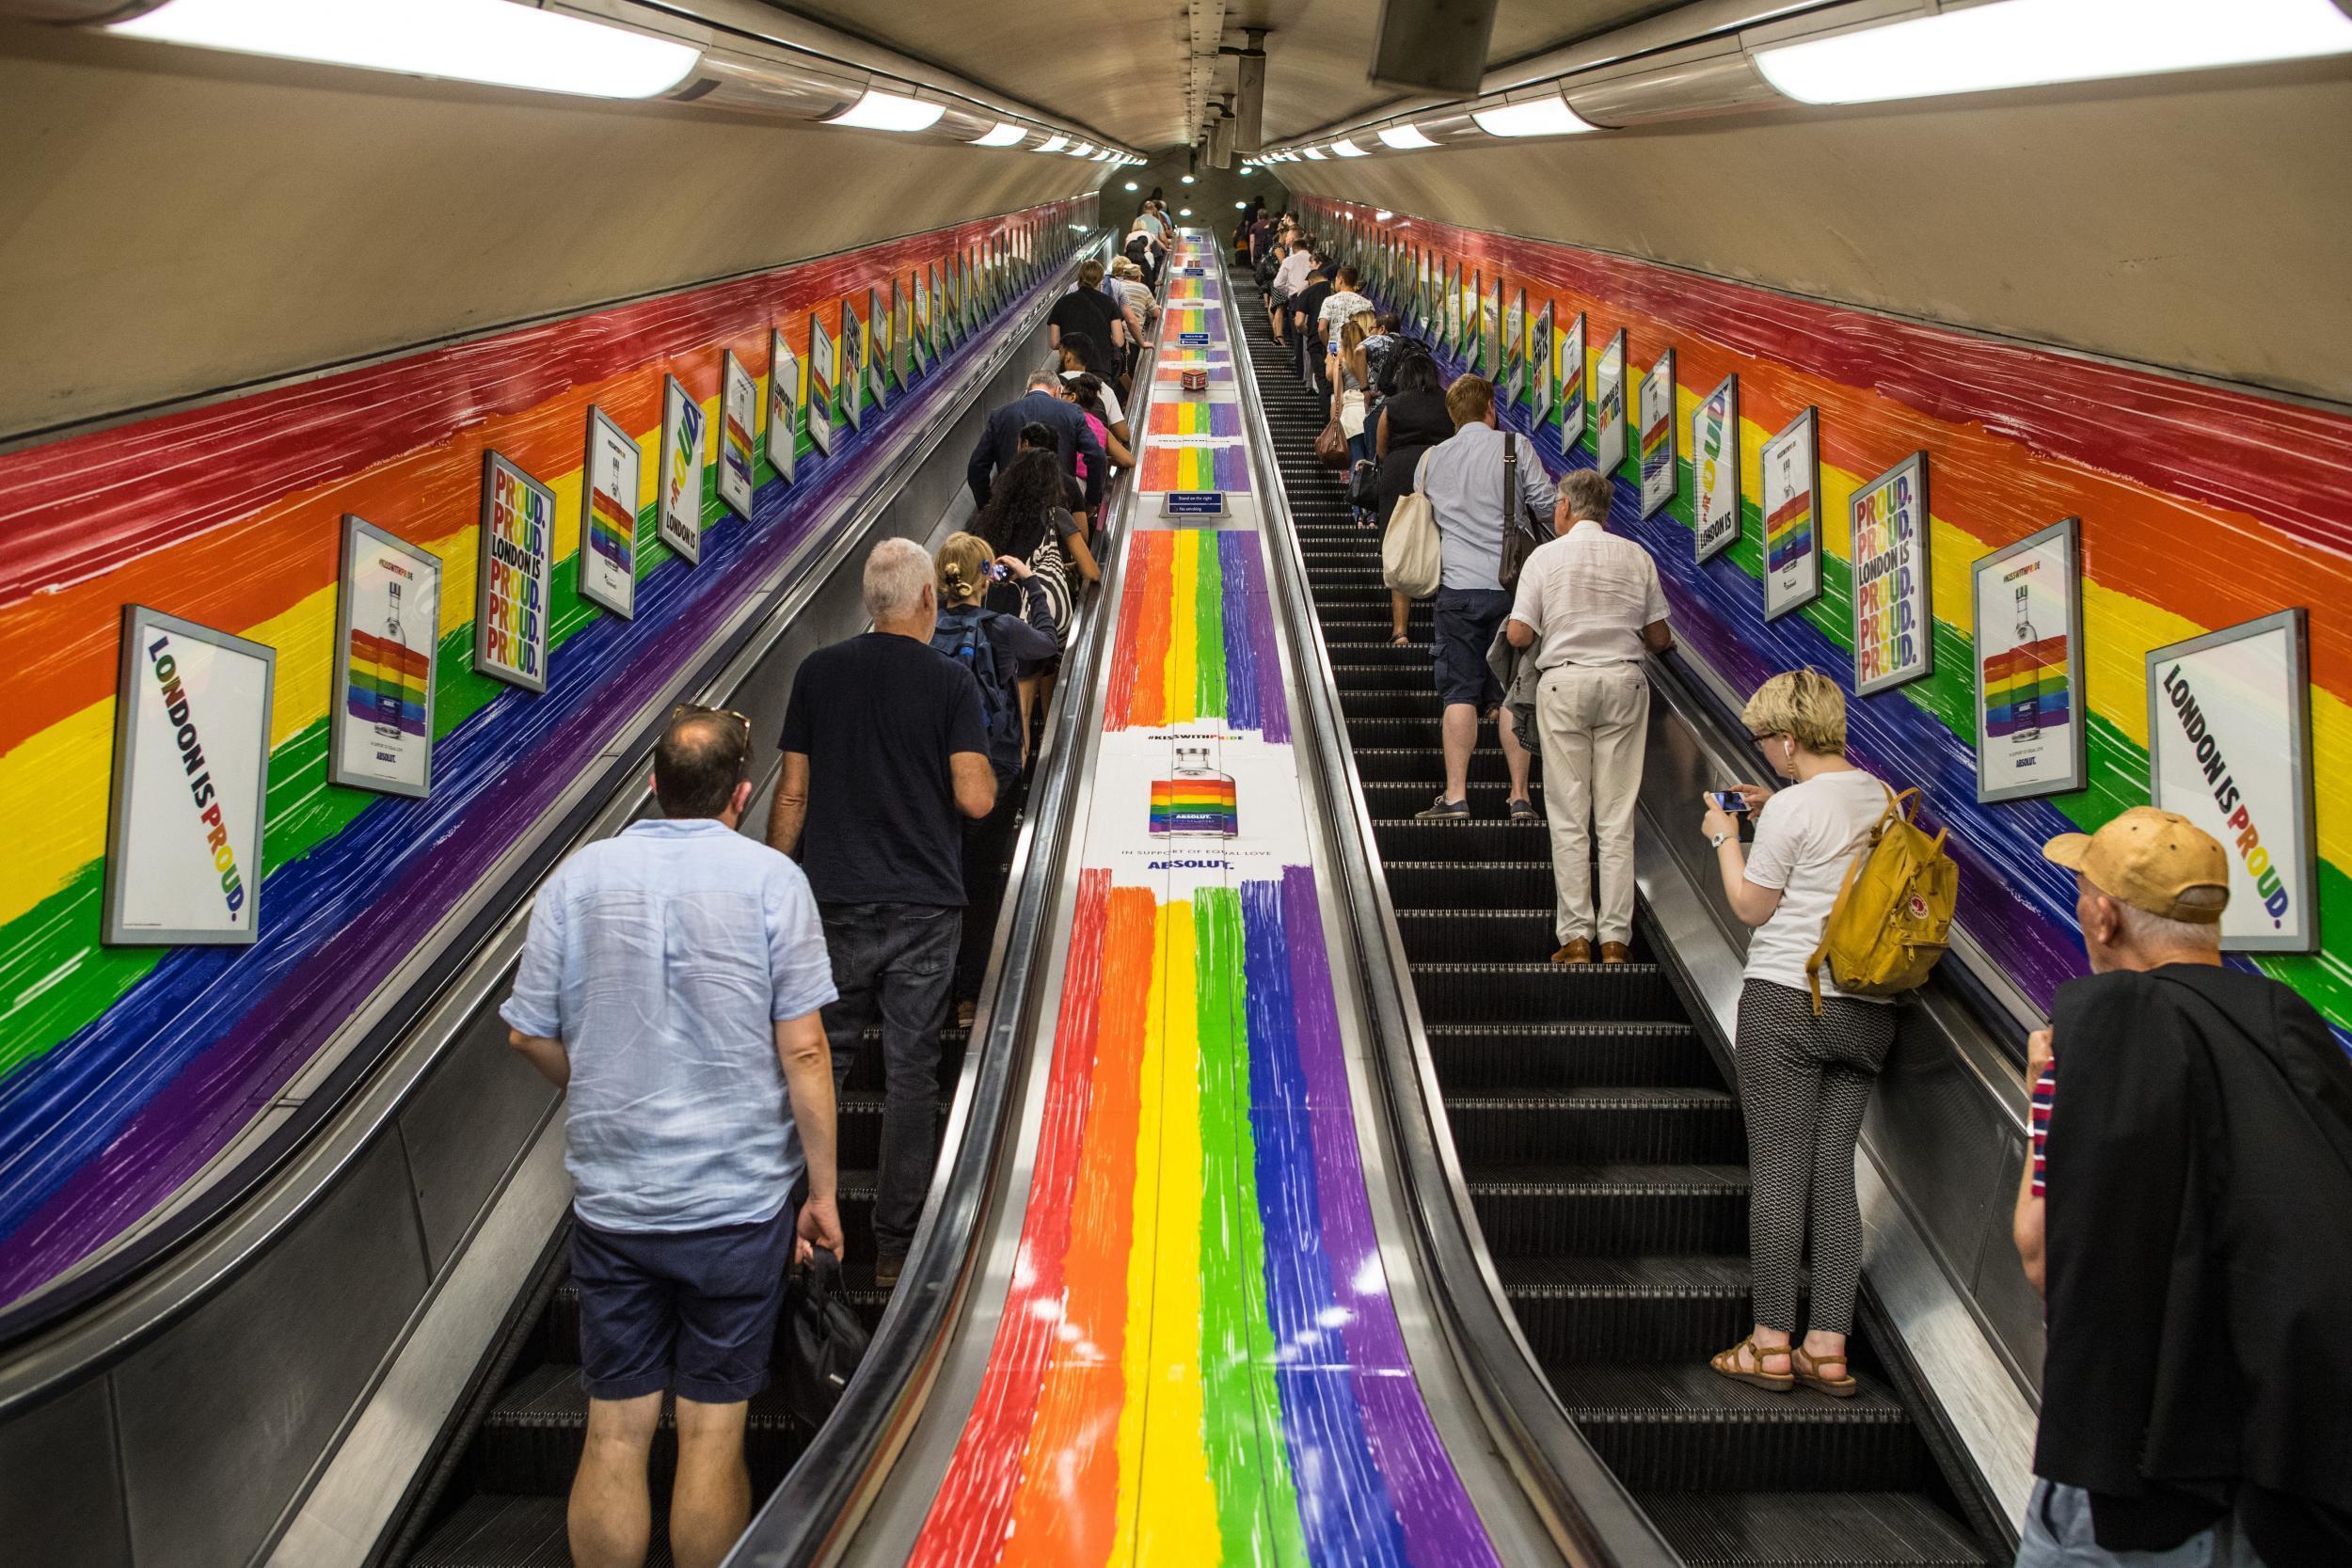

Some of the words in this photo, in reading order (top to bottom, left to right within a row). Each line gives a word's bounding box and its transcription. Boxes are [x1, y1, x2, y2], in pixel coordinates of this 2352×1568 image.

[495, 467, 546, 529] PROUD.
[1856, 475, 1913, 532] PROUD.
[492, 534, 532, 576] LONDON
[531, 556, 541, 579] IS
[493, 499, 545, 561] PROUD.
[666, 511, 690, 545] LONDON
[690, 531, 696, 549] IS
[1700, 516, 1724, 549] LONDON
[1724, 511, 1732, 532] IS
[1857, 509, 1914, 564] PROUD.
[490, 556, 542, 613] PROUD.
[1859, 550, 1899, 586] LONDON
[1899, 540, 1910, 566] IS
[488, 591, 540, 645] PROUD.
[1859, 565, 1915, 618] PROUD.
[1860, 599, 1916, 650] PROUD.
[486, 626, 538, 677] PROUD.
[1862, 633, 1917, 682] PROUD.
[148, 635, 205, 777] LONDON
[190, 770, 215, 810] IS
[2163, 663, 2226, 786] LONDON
[2214, 775, 2240, 815] IS
[2227, 804, 2289, 929] PROUD.
[200, 801, 245, 923] PROUD.
[1148, 860, 1234, 870] ABSOLUT.
